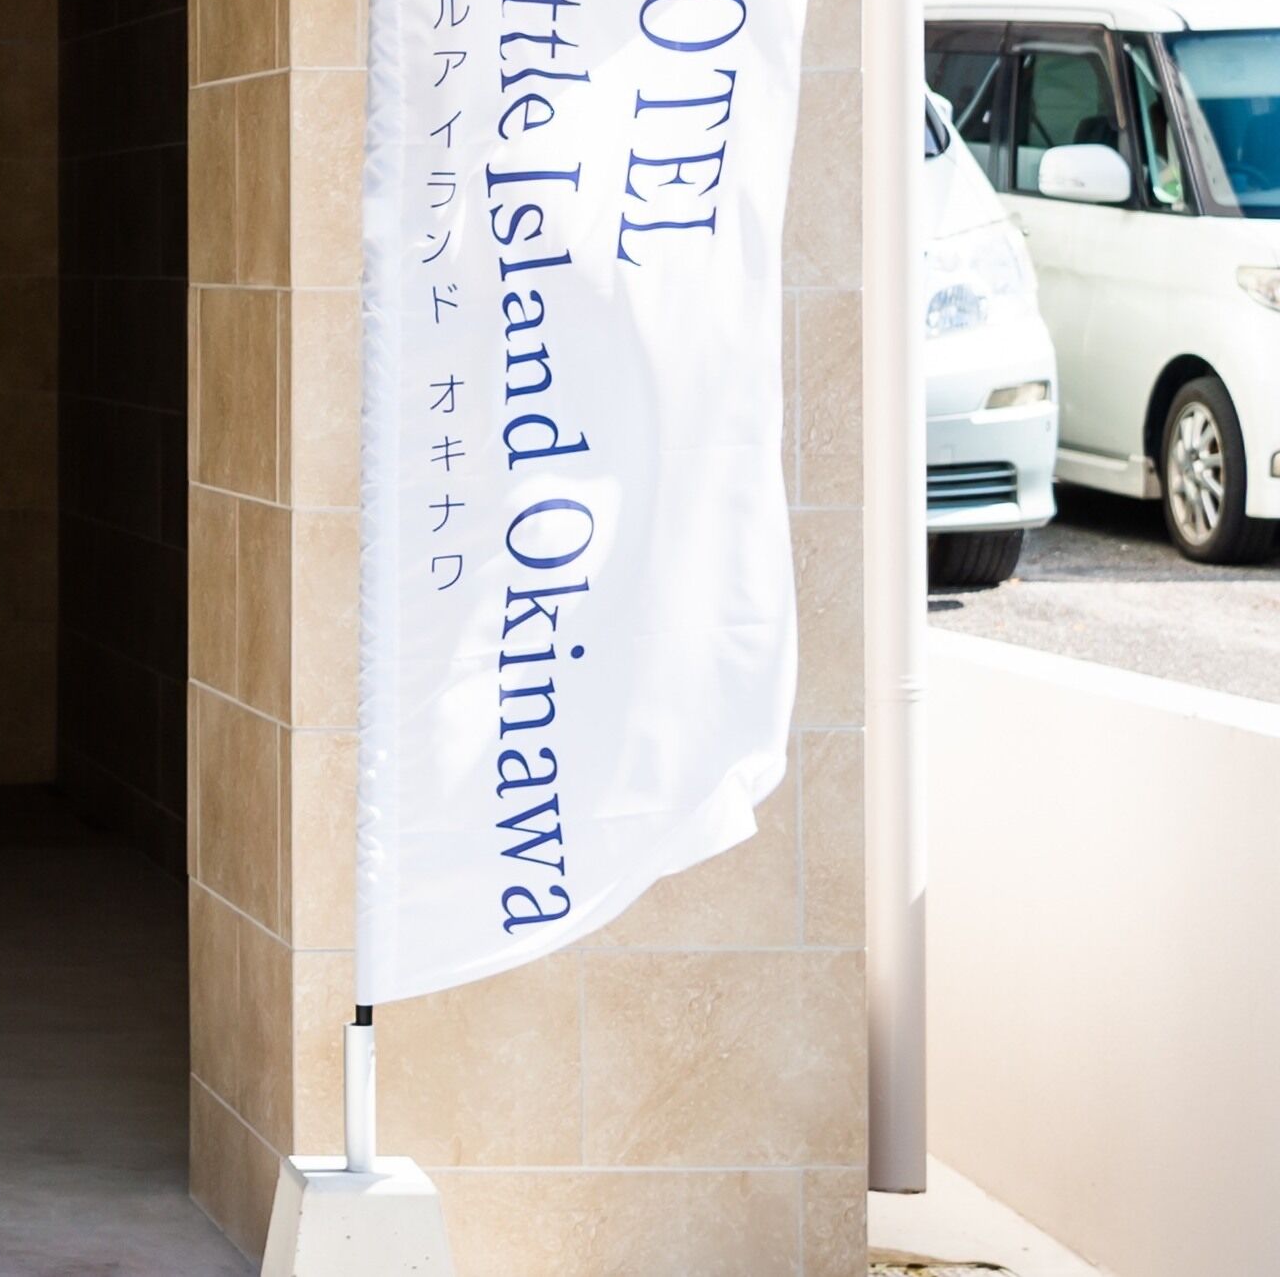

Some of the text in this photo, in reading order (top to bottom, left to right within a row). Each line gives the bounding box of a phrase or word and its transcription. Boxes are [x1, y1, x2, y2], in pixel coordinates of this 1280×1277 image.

[485, 161, 591, 472] Island
[429, 374, 465, 591] オキナワ
[495, 497, 595, 935] Okinawa
